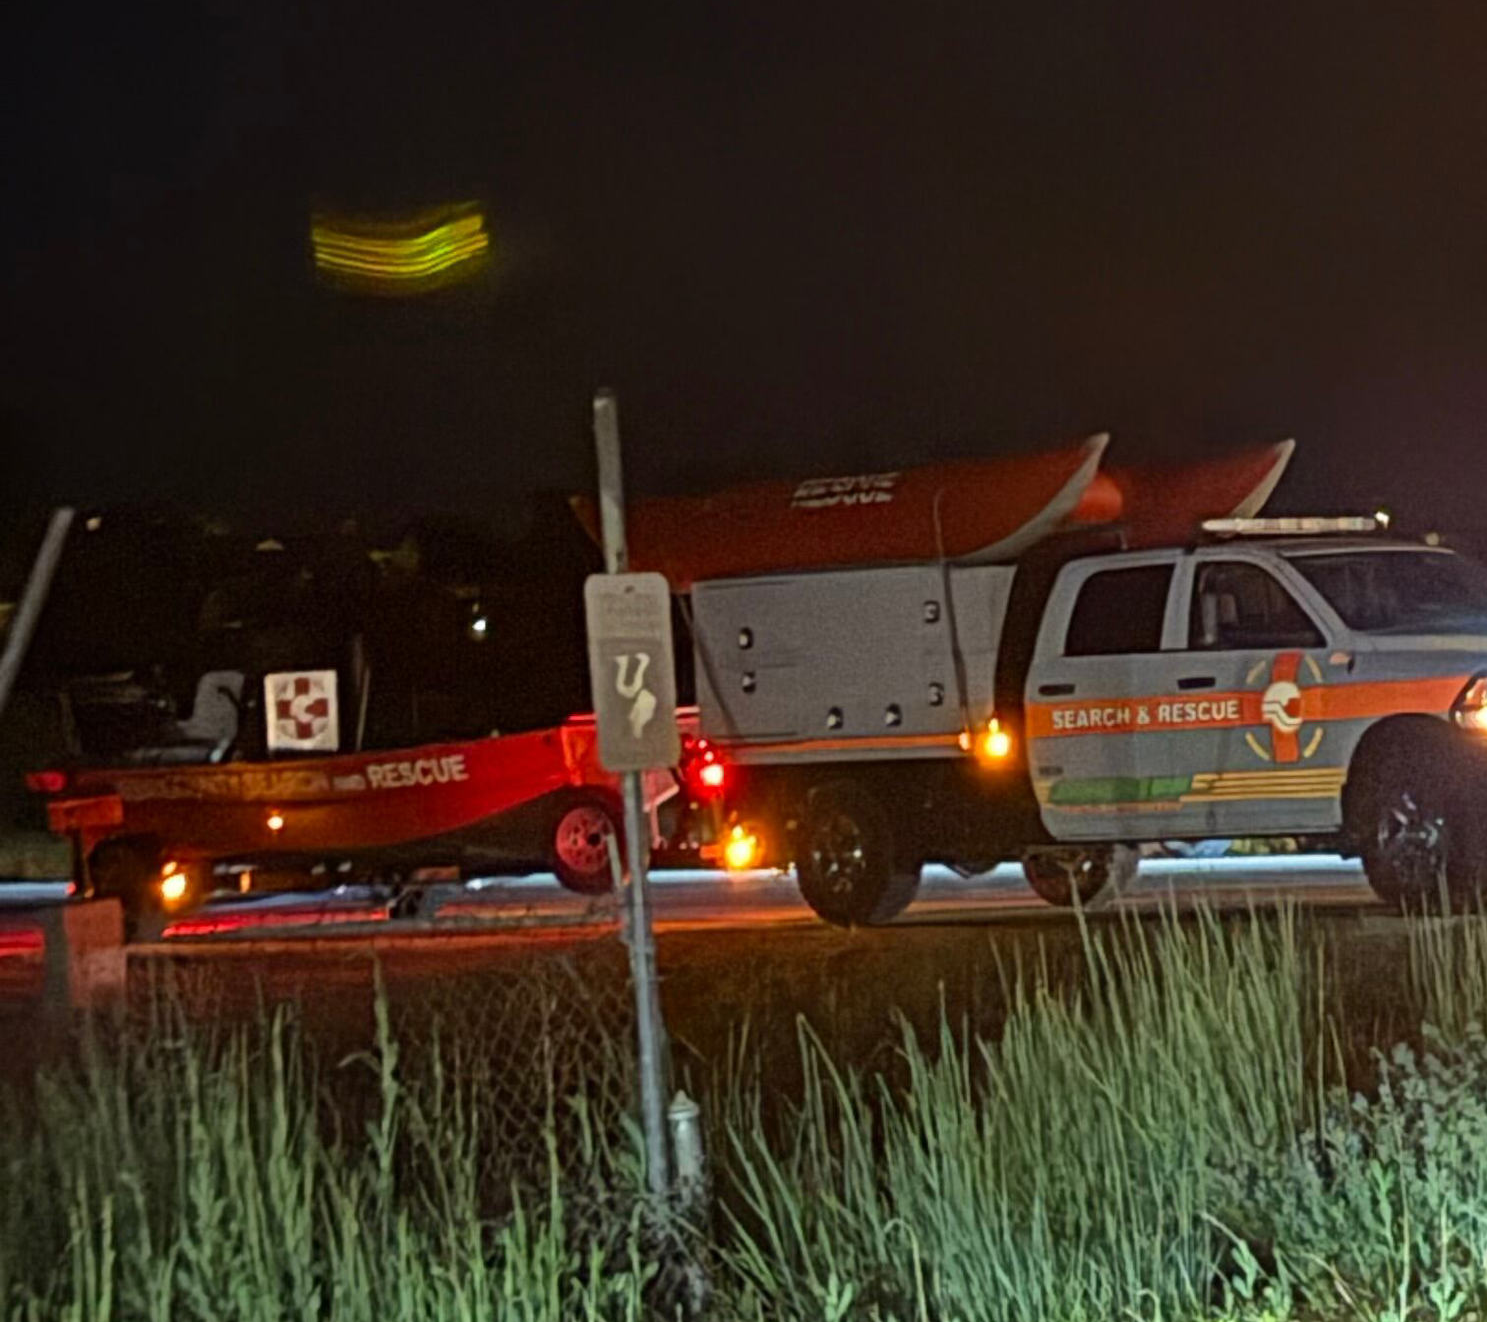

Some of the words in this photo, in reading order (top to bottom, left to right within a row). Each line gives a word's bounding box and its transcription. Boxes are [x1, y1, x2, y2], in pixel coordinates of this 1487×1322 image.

[1051, 706, 1131, 730] SEARCH
[1136, 705, 1151, 725] &
[1157, 699, 1240, 724] RESCUE
[366, 753, 470, 790] RESCUE
